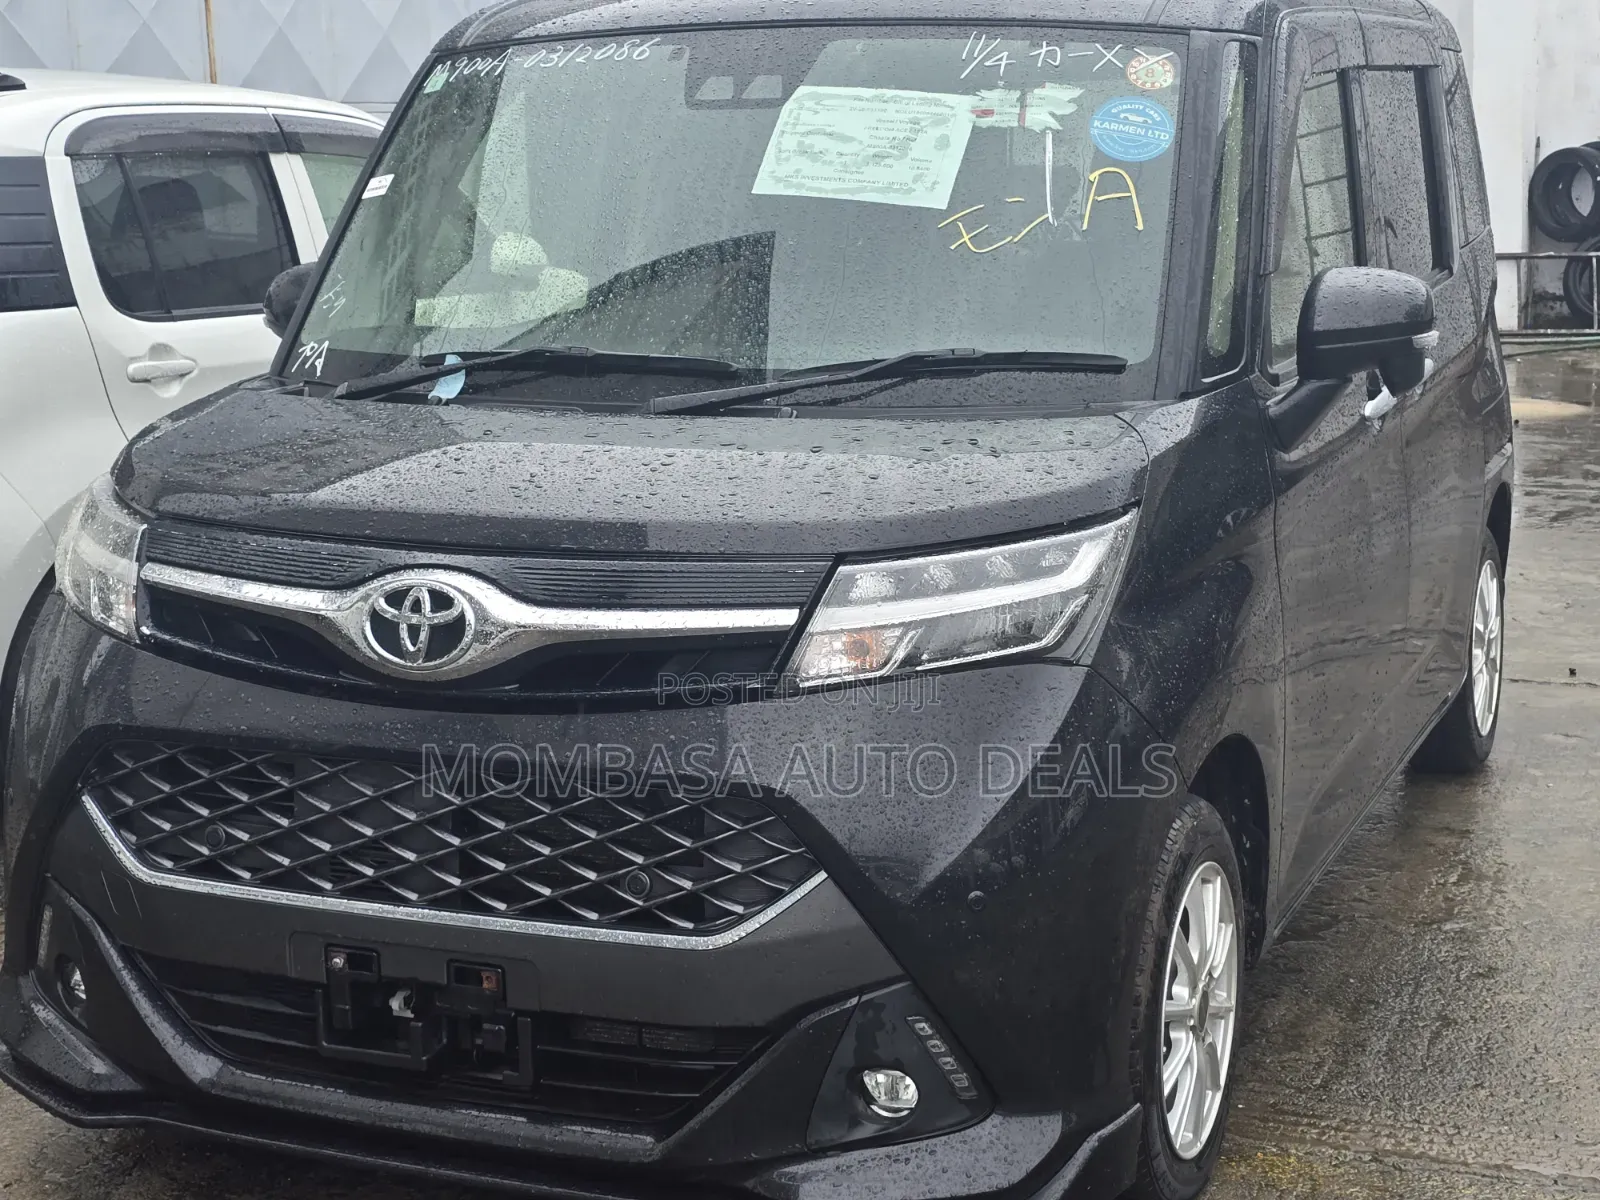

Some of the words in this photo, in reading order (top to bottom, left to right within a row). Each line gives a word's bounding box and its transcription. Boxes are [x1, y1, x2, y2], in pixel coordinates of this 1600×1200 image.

[1111, 104, 1144, 113] QUALITY
[1093, 120, 1145, 135] KARMEN
[1147, 129, 1170, 140] LTD
[1082, 167, 1144, 231] A
